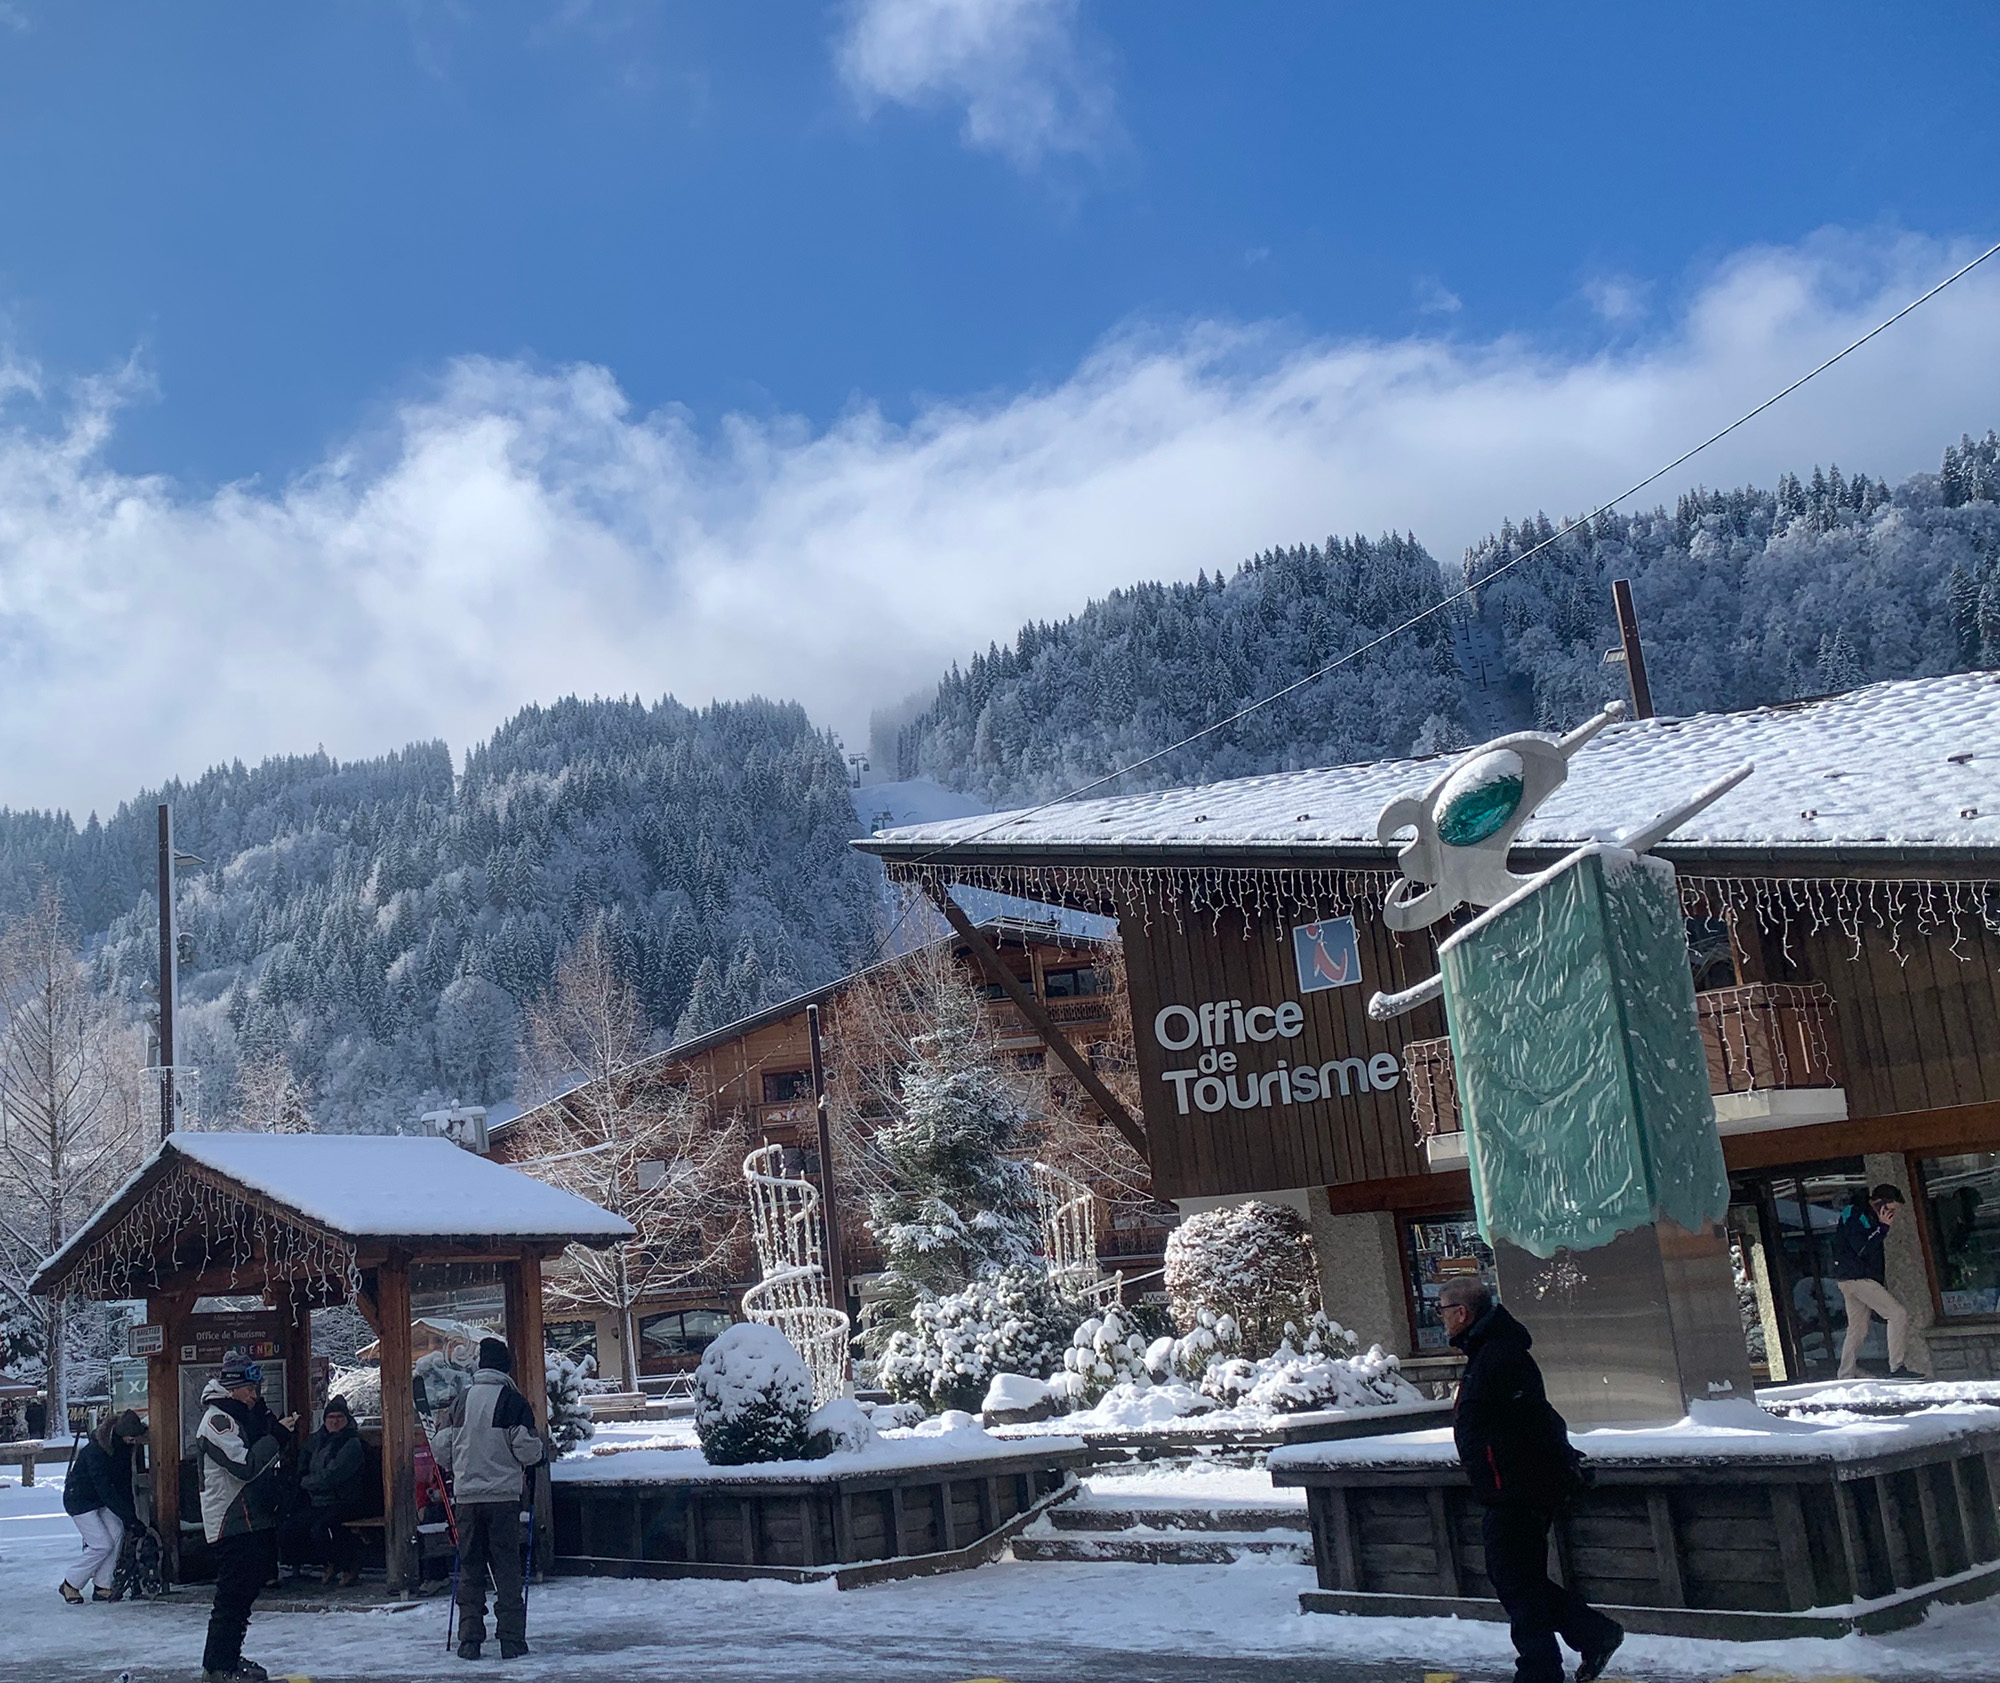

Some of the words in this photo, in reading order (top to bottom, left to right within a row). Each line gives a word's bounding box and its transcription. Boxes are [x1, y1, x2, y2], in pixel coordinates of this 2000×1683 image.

[1154, 1000, 1304, 1051] Office
[1198, 1048, 1238, 1074] de
[1161, 1052, 1400, 1115] Tourisme
[196, 1330, 220, 1341] Office
[221, 1330, 231, 1340] de
[232, 1328, 267, 1340] Tourisme
